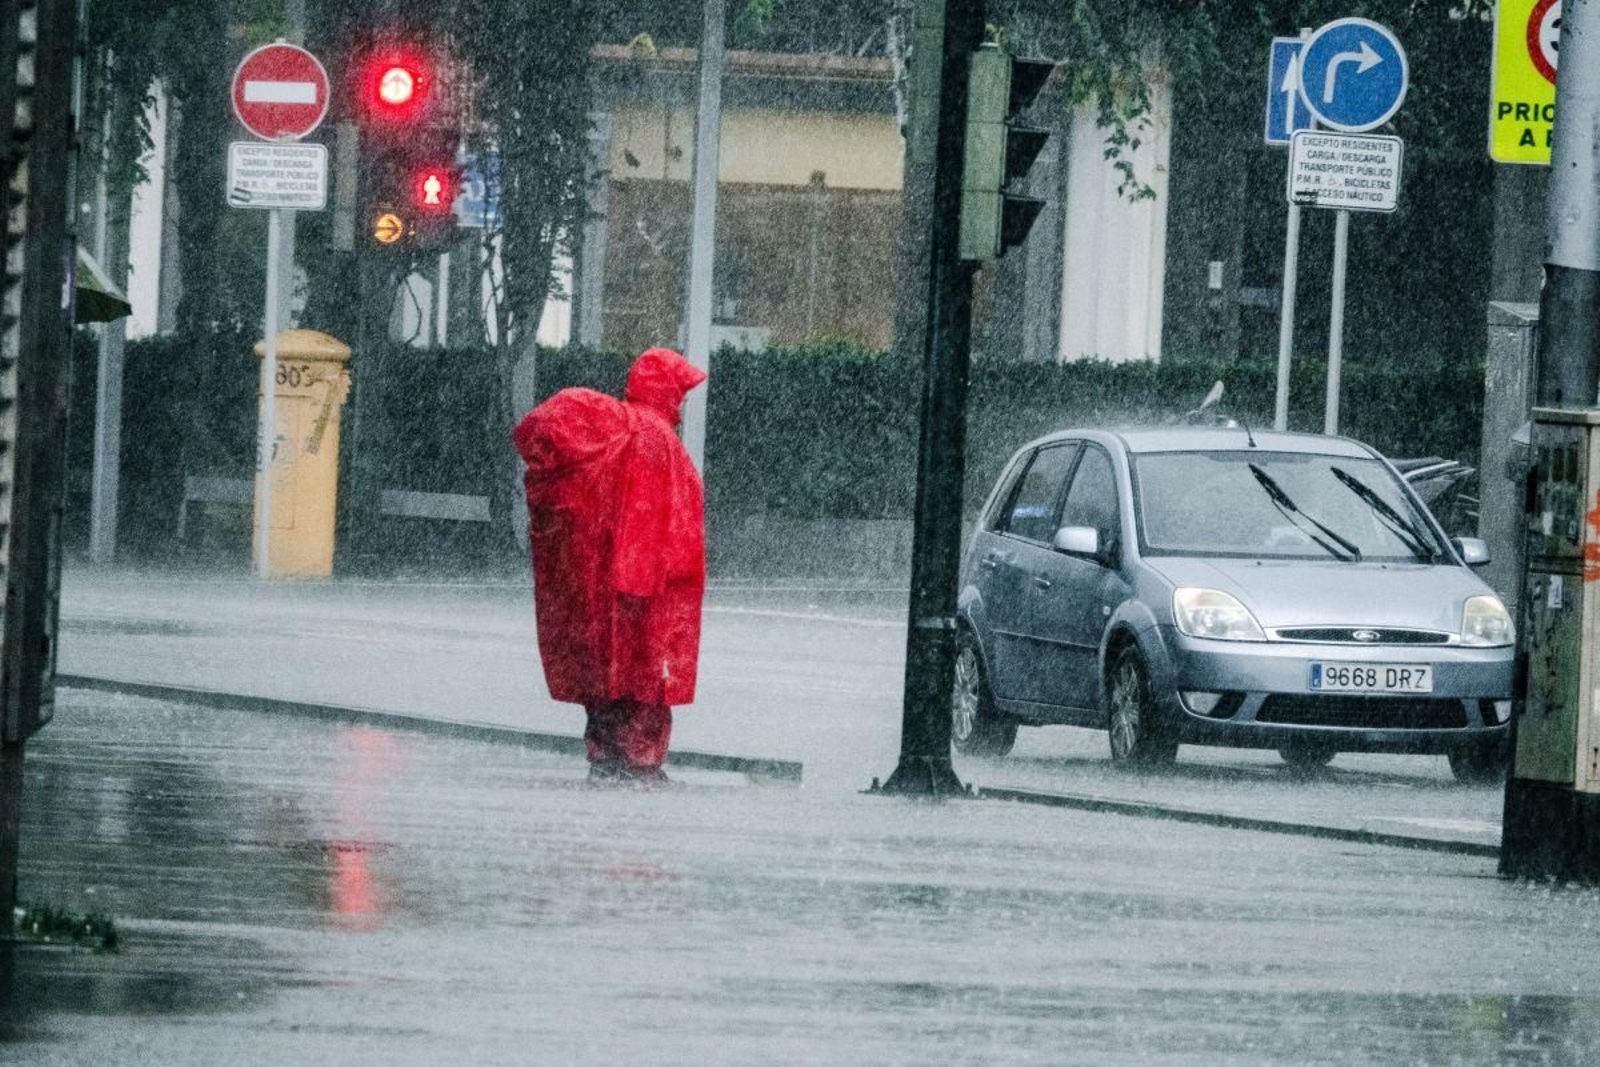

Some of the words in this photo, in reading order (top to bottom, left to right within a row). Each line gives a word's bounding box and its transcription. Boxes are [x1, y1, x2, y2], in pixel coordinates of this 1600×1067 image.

[1302, 137, 1339, 149] EXCEPTO
[1341, 140, 1393, 152] RESIDENTES
[1519, 128, 1536, 147] A
[1307, 150, 1335, 160] CARGA
[1341, 153, 1386, 164] DESCARGA
[1300, 162, 1355, 175] TRANSPORTE
[1344, 178, 1391, 190] BICICLETAS
[1346, 189, 1384, 202] NÁUTICO
[1325, 667, 1377, 687] 9668
[1385, 668, 1426, 689] DRZ
